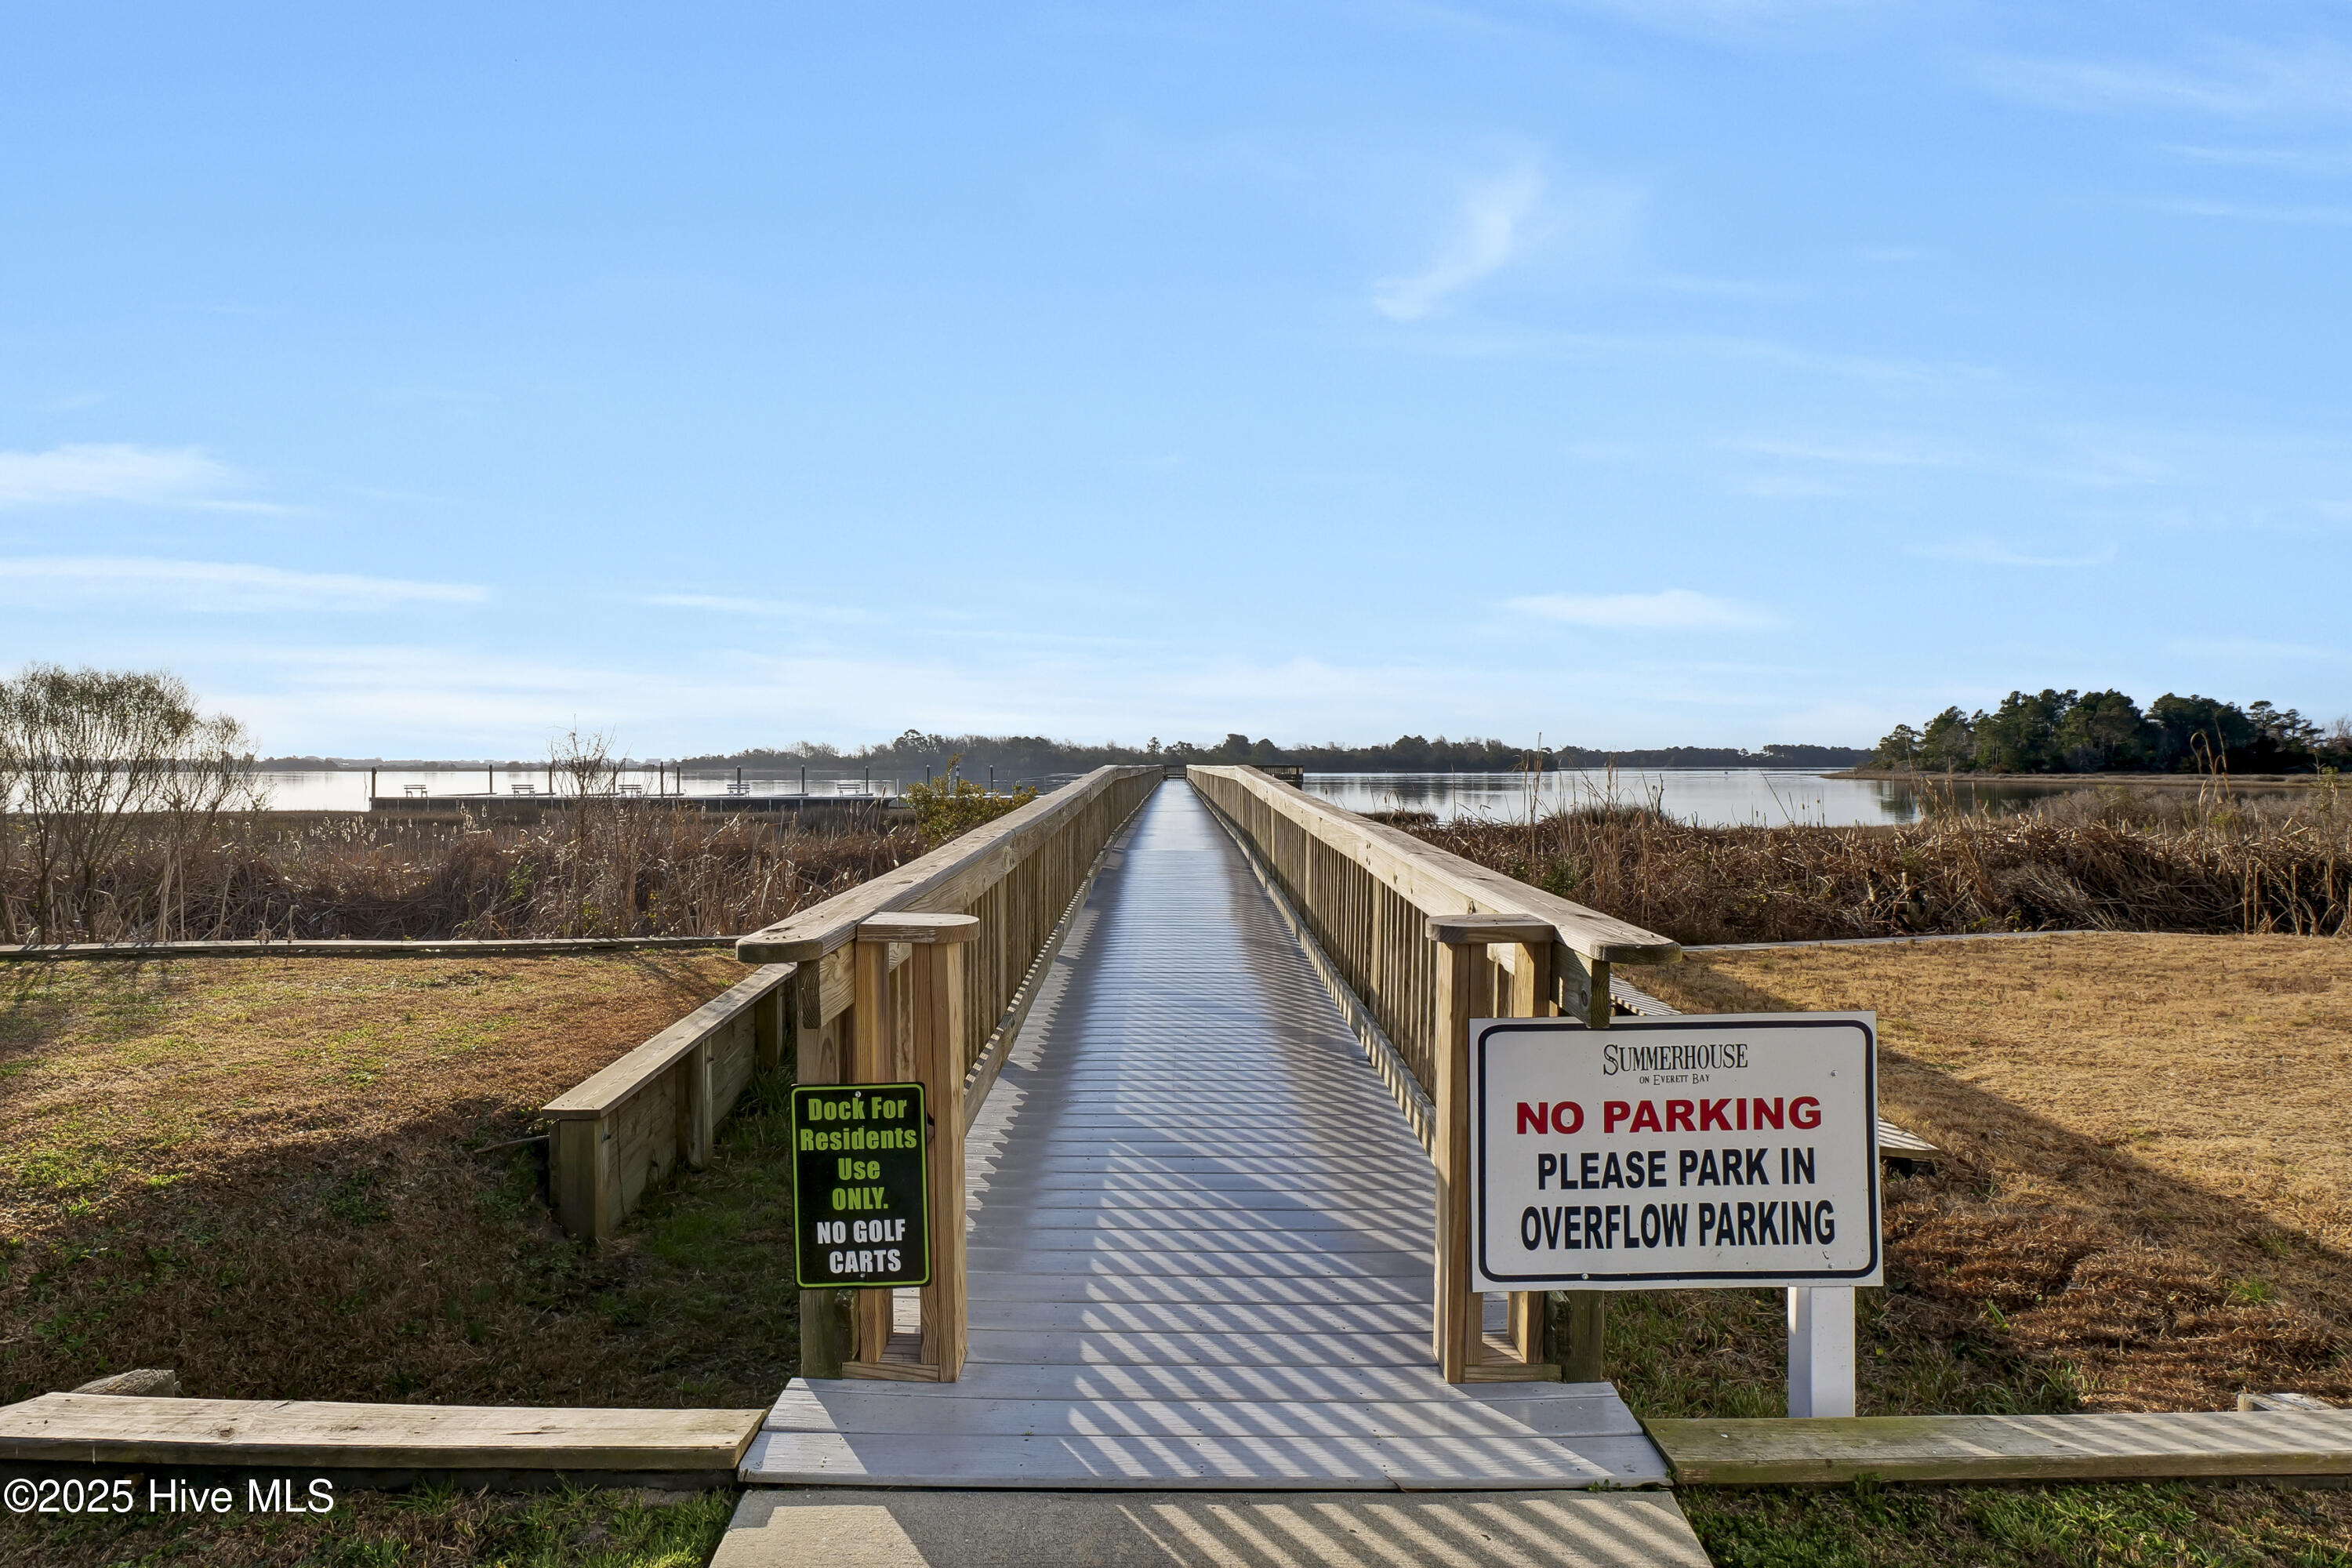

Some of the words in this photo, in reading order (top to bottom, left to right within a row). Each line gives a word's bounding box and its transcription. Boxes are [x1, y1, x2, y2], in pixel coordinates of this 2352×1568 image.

[808, 1098, 865, 1120] Dock
[872, 1097, 907, 1120] For
[1516, 1101, 1584, 1134] NO
[1603, 1096, 1822, 1134] PARKING
[800, 1127, 916, 1151] Residents
[838, 1158, 880, 1180] Use
[1537, 1150, 1667, 1190] PLEASE
[1679, 1148, 1769, 1187] PARK
[1781, 1147, 1816, 1185] IN
[832, 1187, 888, 1210] ONLY.
[816, 1221, 846, 1244] NO
[853, 1219, 906, 1243] GOLF
[1521, 1203, 1688, 1250] OVERFLOW
[1699, 1200, 1835, 1247] PARKING
[829, 1249, 901, 1273] CARTS
